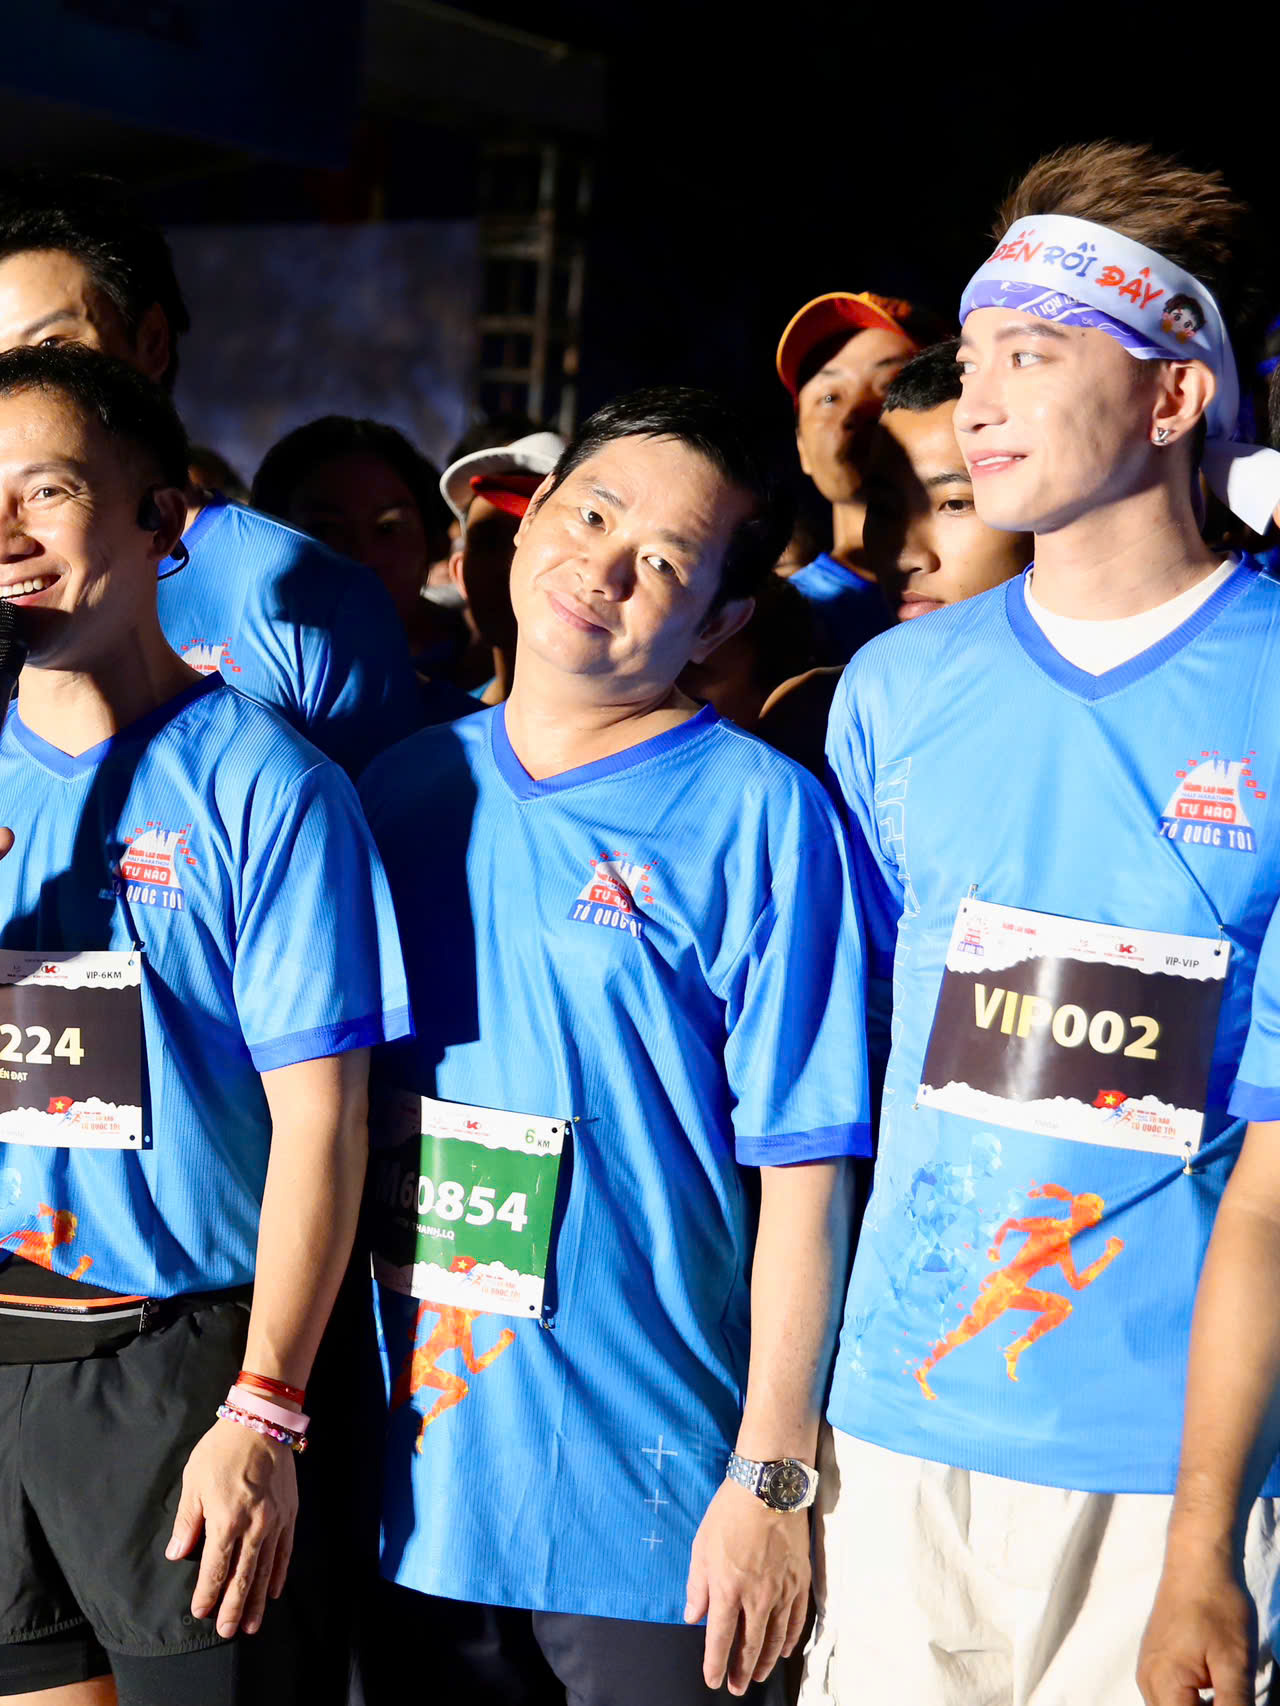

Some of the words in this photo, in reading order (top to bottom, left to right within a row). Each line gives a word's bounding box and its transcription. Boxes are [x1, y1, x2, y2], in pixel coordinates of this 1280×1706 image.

[1095, 265, 1164, 310] ĐÂY
[1165, 955, 1200, 968] VIP-VIP
[86, 970, 122, 980] VIP-6KM
[974, 982, 1161, 1061] VIP002
[525, 1129, 536, 1144] 6
[537, 1139, 550, 1149] KM
